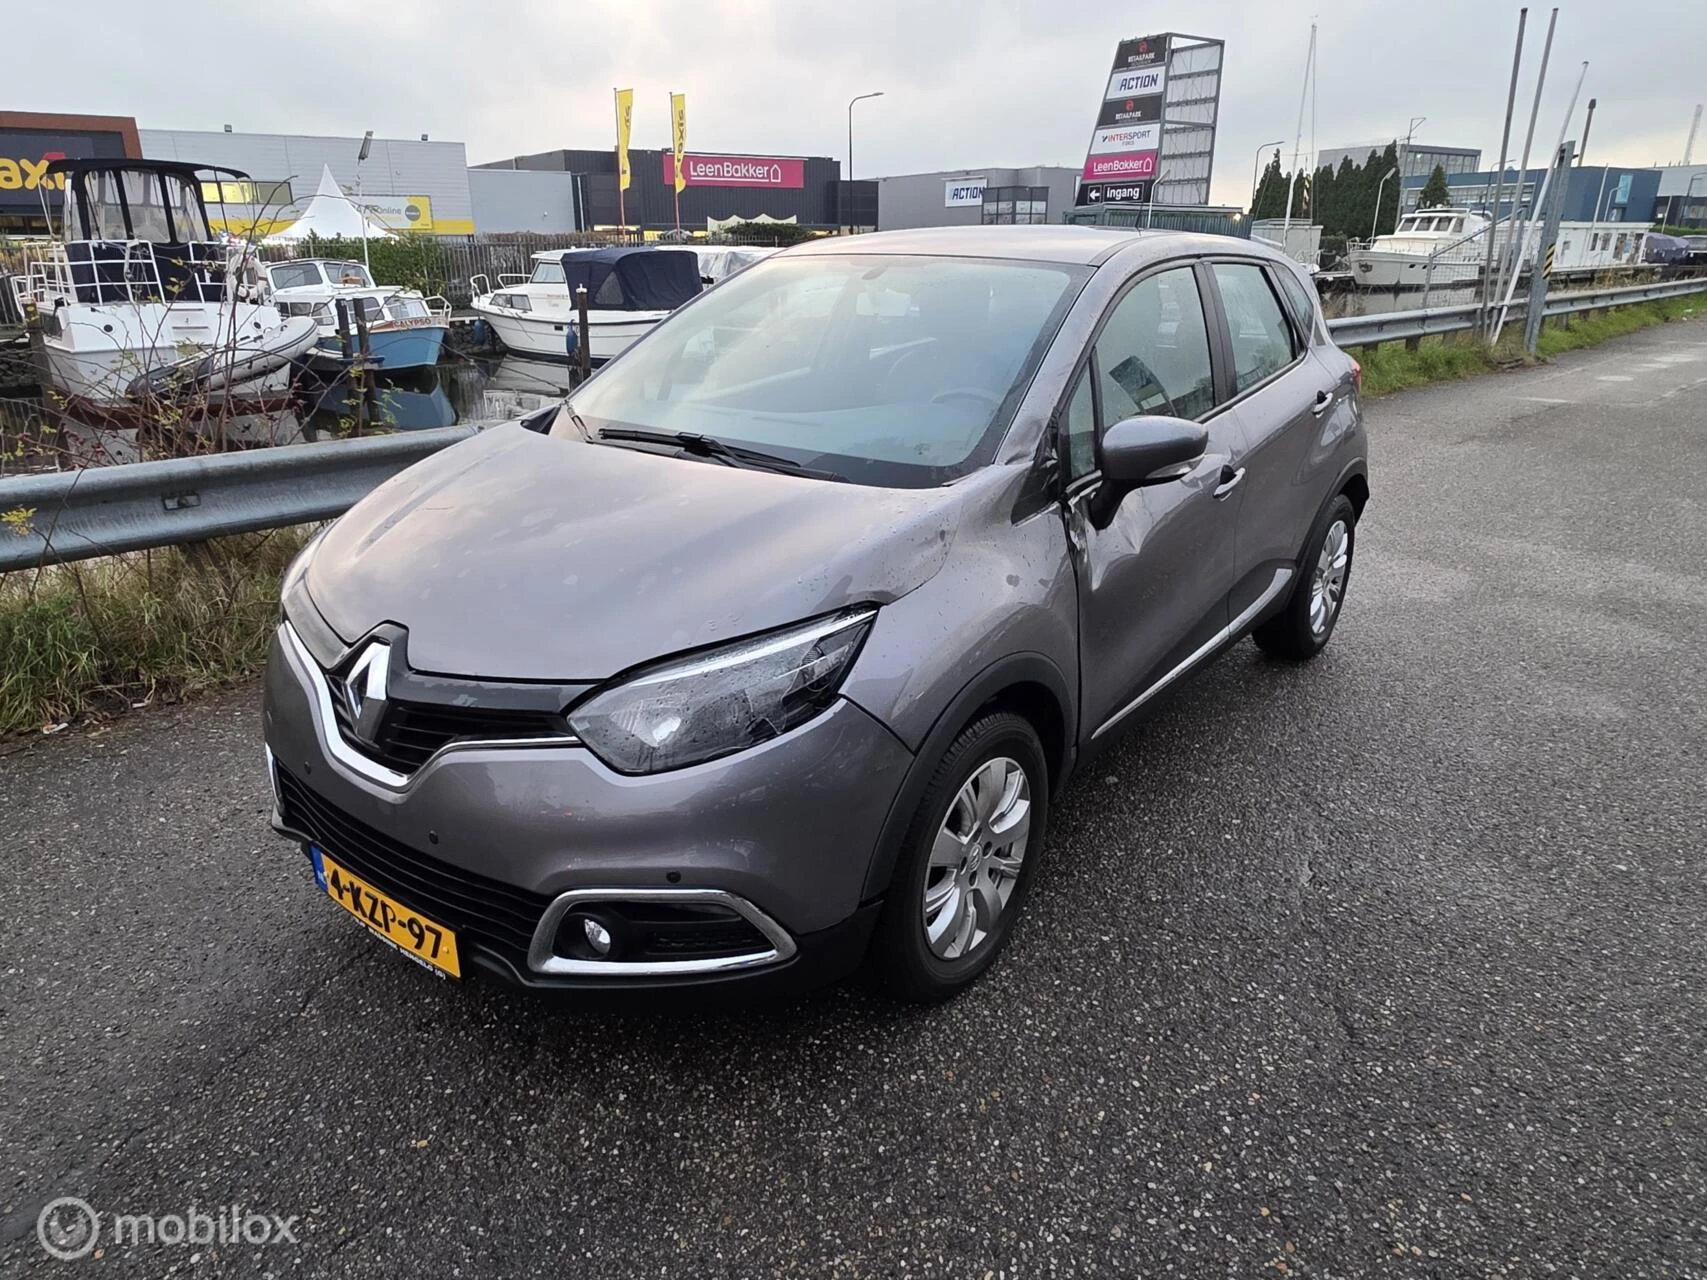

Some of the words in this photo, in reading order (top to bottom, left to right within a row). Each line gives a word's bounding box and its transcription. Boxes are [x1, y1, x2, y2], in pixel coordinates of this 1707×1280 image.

[1120, 73, 1159, 91] ACTION
[1108, 130, 1151, 142] INTERSPORT
[690, 161, 769, 178] LeenBakker
[1093, 159, 1143, 172] LeenBakker
[330, 868, 442, 959] 4-KZP-97
